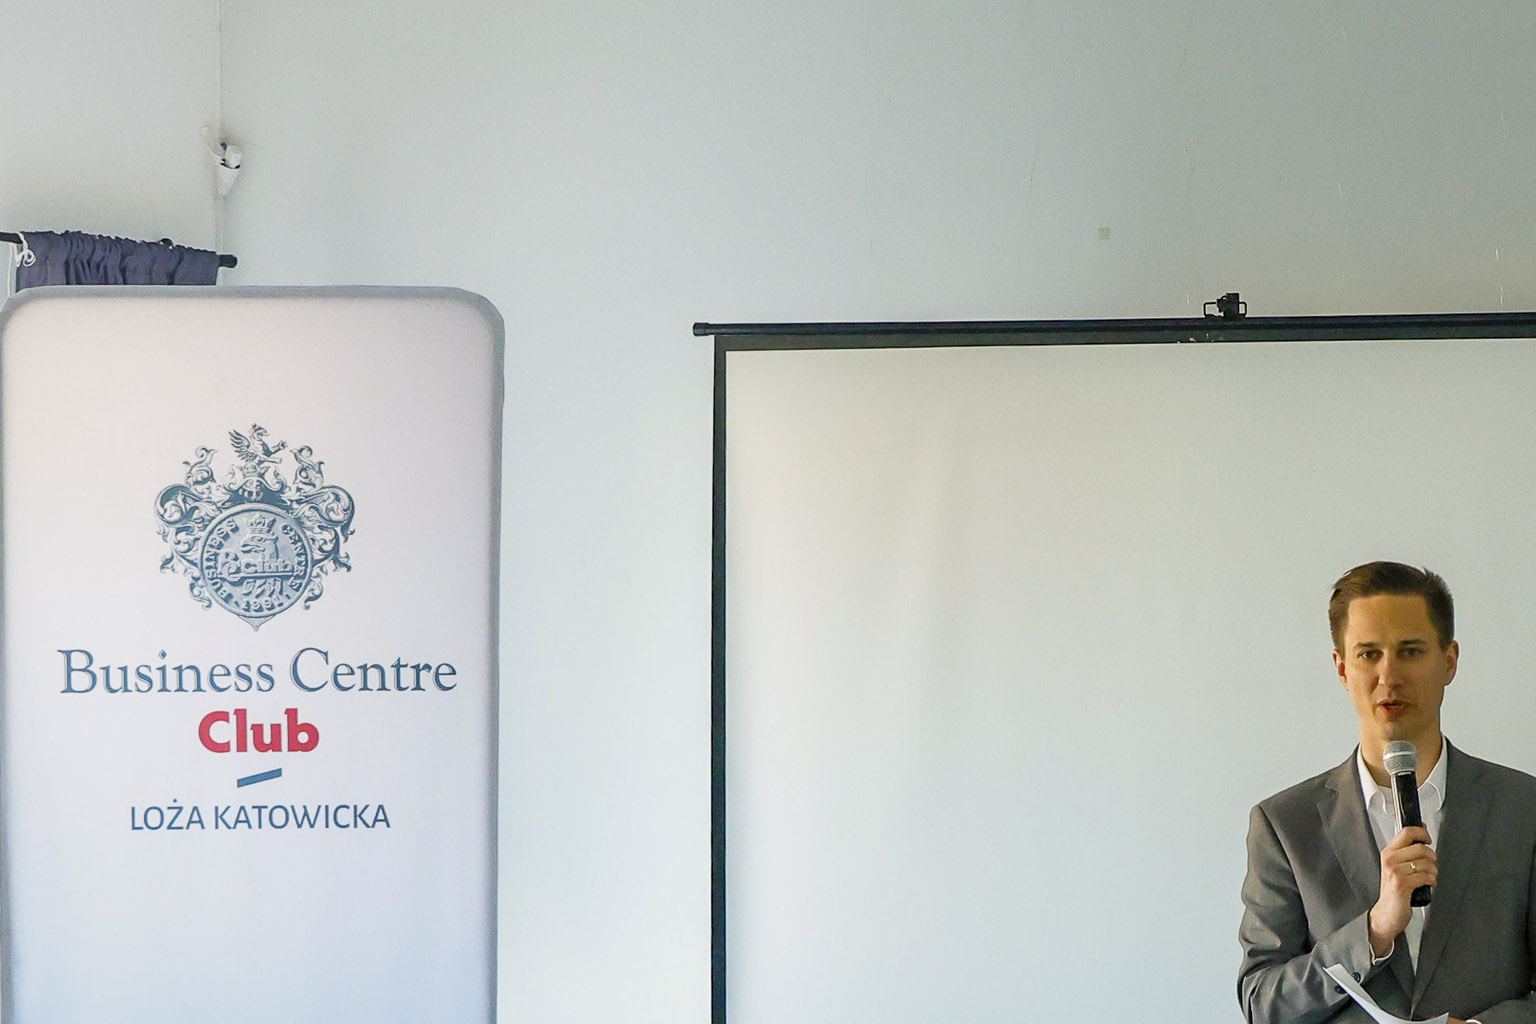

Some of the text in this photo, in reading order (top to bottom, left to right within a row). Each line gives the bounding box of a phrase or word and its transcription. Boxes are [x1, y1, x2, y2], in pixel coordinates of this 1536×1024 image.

[57, 646, 458, 694] Business Centre
[198, 708, 320, 753] Club
[130, 799, 391, 831] LOŻA KATOWICKA
